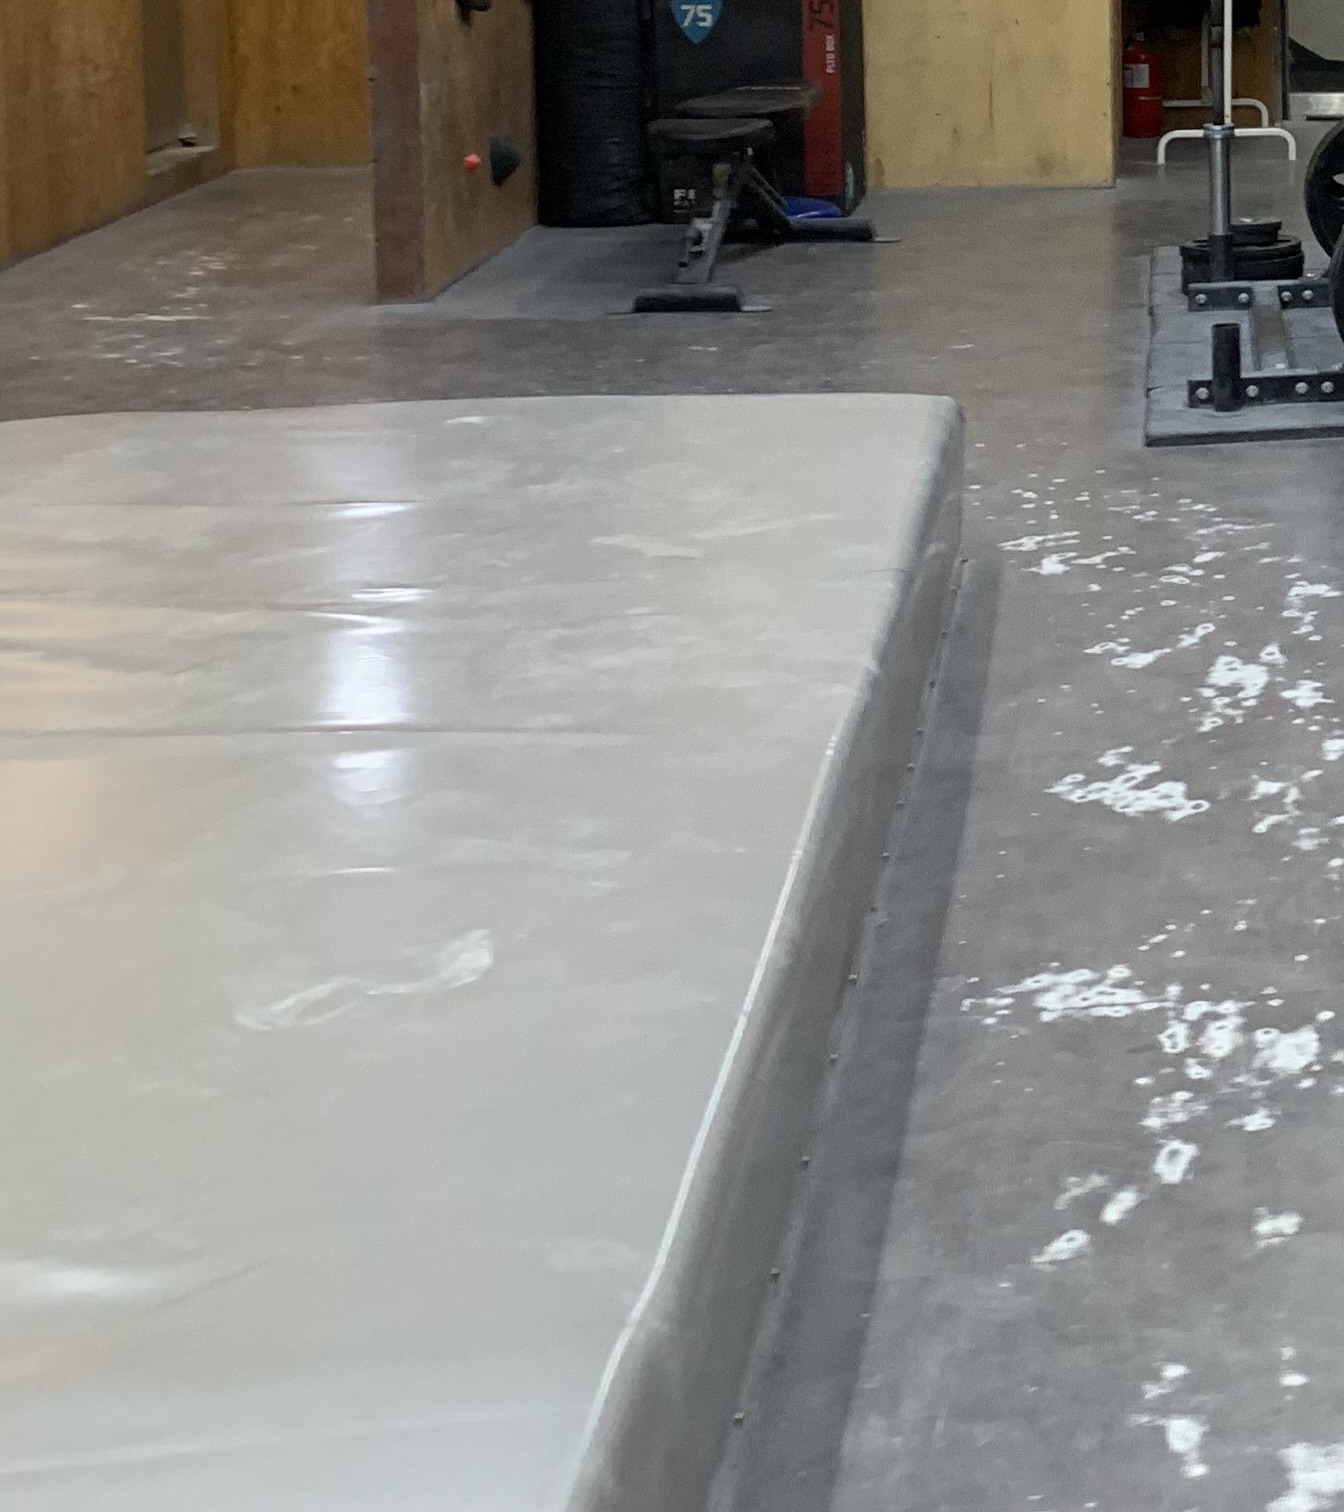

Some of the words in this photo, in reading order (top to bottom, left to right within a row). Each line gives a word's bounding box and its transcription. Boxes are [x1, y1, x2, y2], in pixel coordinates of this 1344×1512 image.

[680, 4, 712, 27] 75
[807, 0, 833, 31] 75
[825, 34, 835, 52] BOX
